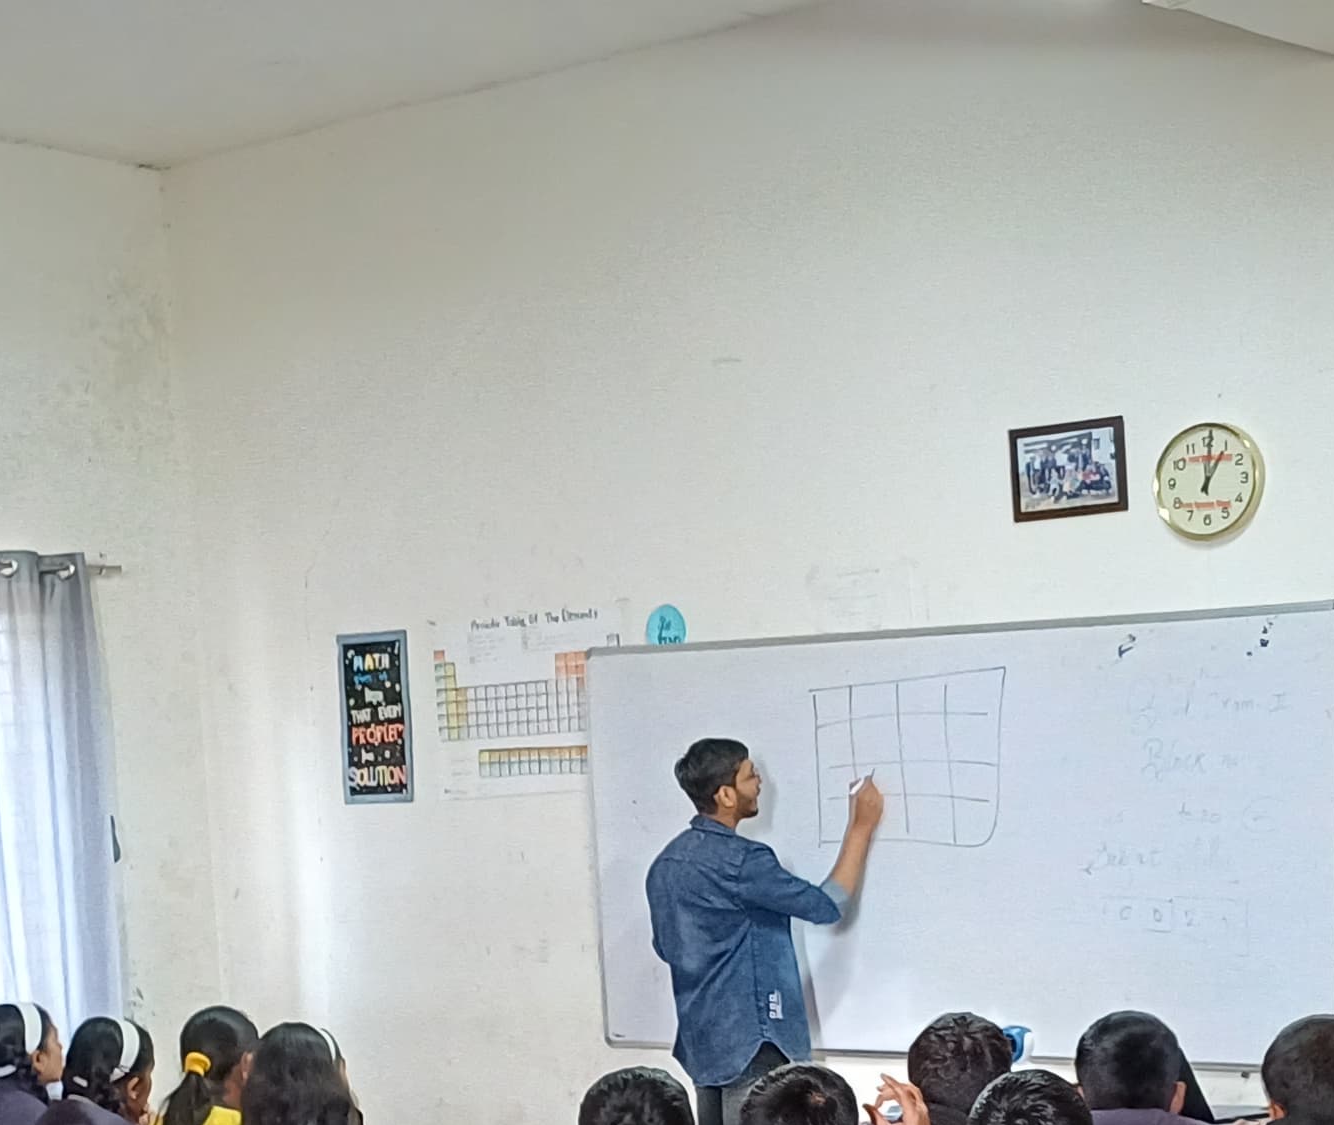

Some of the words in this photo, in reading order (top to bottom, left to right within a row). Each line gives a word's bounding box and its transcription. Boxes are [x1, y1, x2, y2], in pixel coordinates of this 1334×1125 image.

[1186, 443, 1196, 454] 11
[1224, 440, 1228, 452] 1
[1173, 457, 1187, 471] 10
[1234, 453, 1244, 466] 2
[1240, 471, 1249, 484] 3
[1168, 478, 1176, 490] 9
[1173, 497, 1182, 509] 8
[1235, 492, 1243, 503] 4
[1186, 510, 1194, 521] 7
[1221, 507, 1230, 519] 5
[1203, 514, 1211, 526] 6
[353, 653, 390, 672] MATH
[351, 708, 372, 724] THAT
[348, 765, 407, 787] SOLUTION
